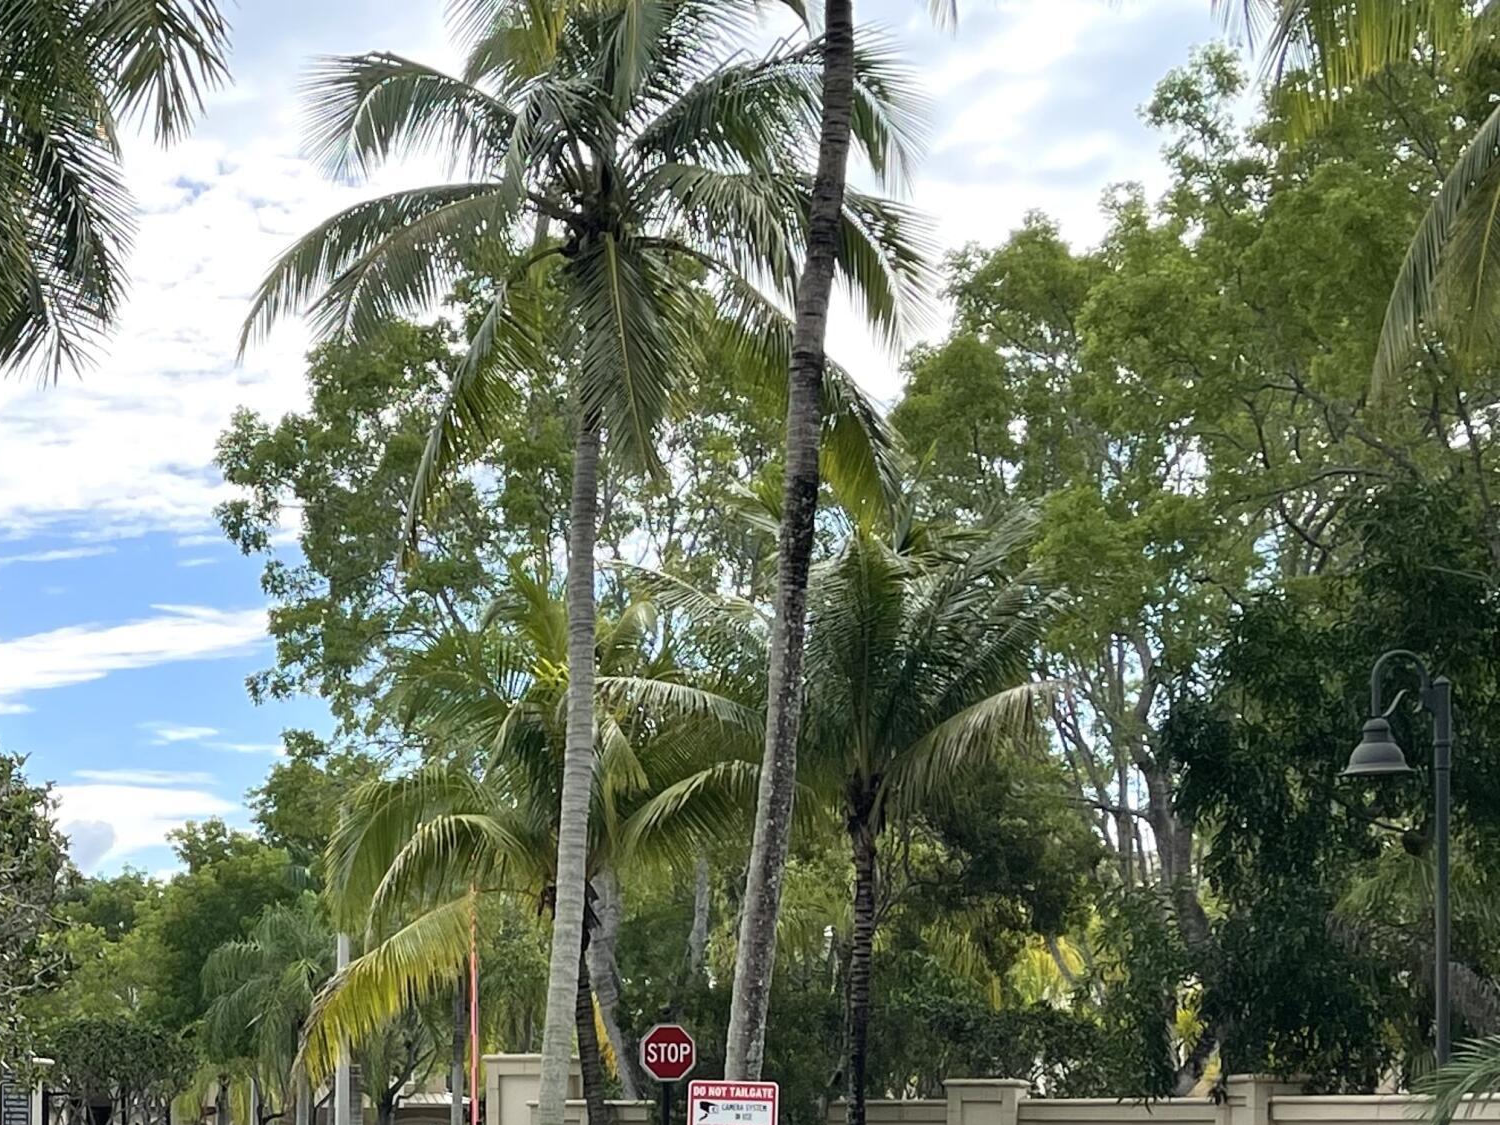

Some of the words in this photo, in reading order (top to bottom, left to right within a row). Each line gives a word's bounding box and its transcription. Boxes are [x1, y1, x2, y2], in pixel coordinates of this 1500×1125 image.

[647, 1042, 691, 1063] STOP
[693, 1086, 706, 1097] DO
[708, 1086, 727, 1097] NOT
[729, 1087, 774, 1099] TAILGATE
[721, 1103, 744, 1111] CAMERA
